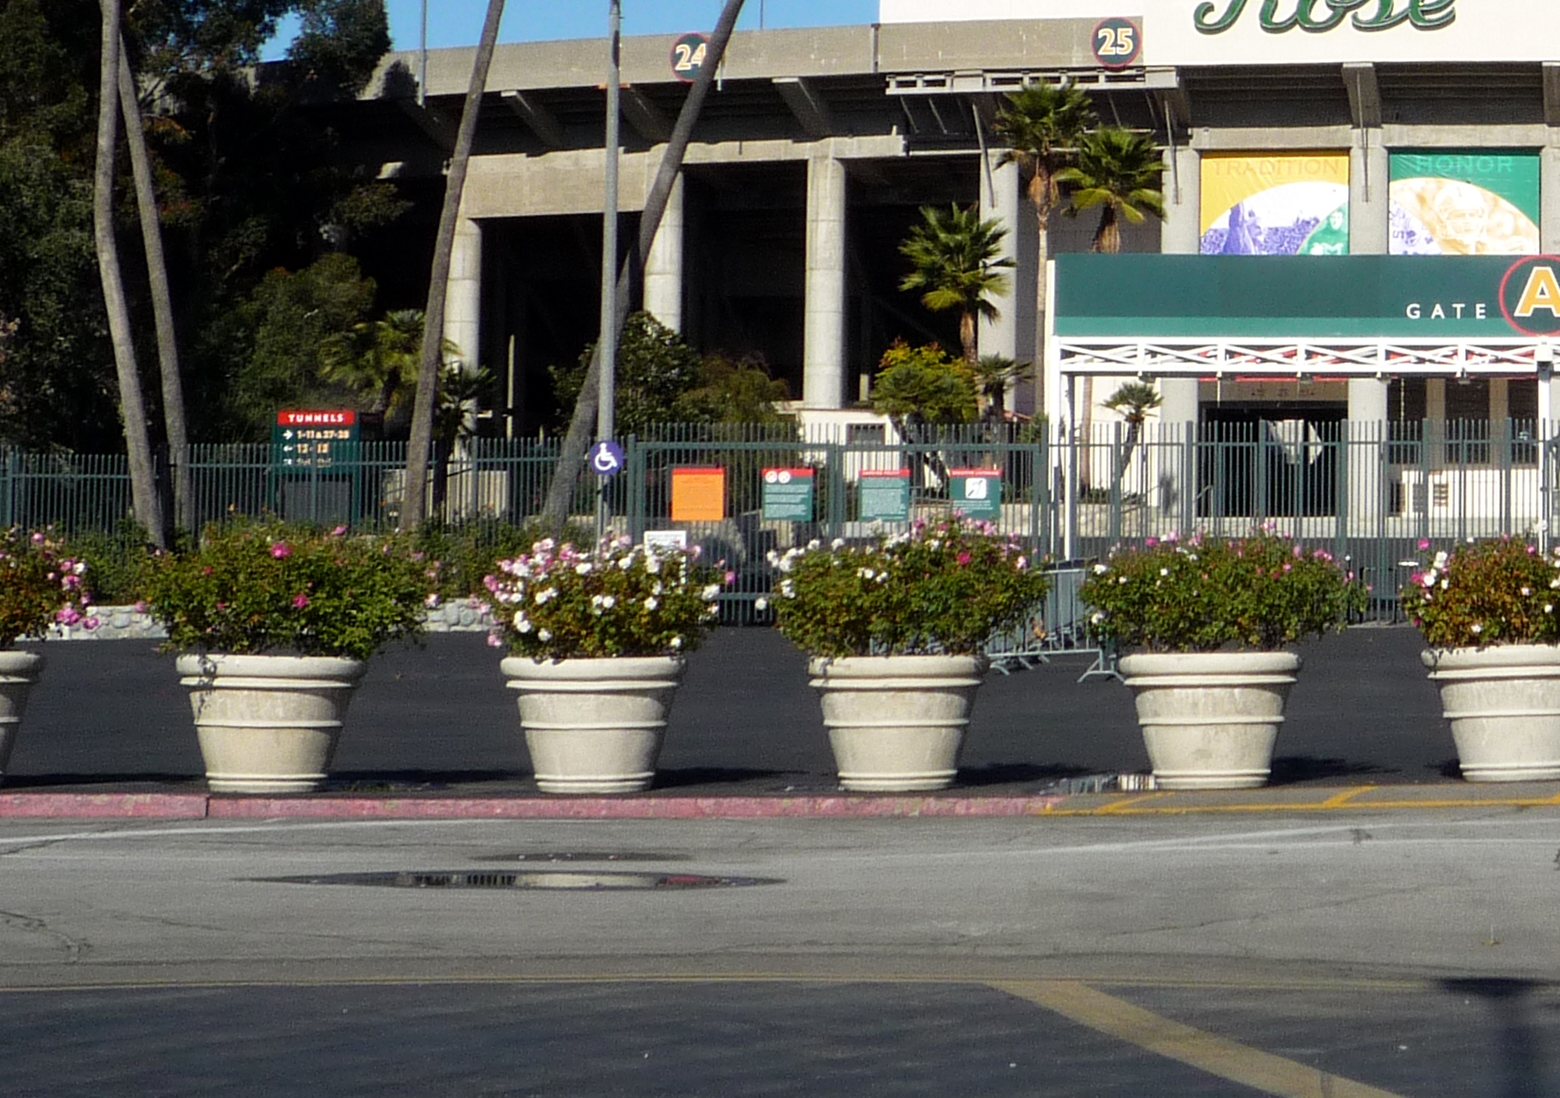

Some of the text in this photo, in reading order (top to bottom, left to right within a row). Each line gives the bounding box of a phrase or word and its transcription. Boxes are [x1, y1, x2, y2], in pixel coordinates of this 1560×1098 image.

[1097, 28, 1134, 55] 25
[675, 43, 707, 71] 24
[1212, 159, 1341, 175] TRADITION
[1415, 157, 1513, 172] HONOR
[1405, 303, 1487, 320] GATE
[288, 413, 344, 422] TUNNELS
